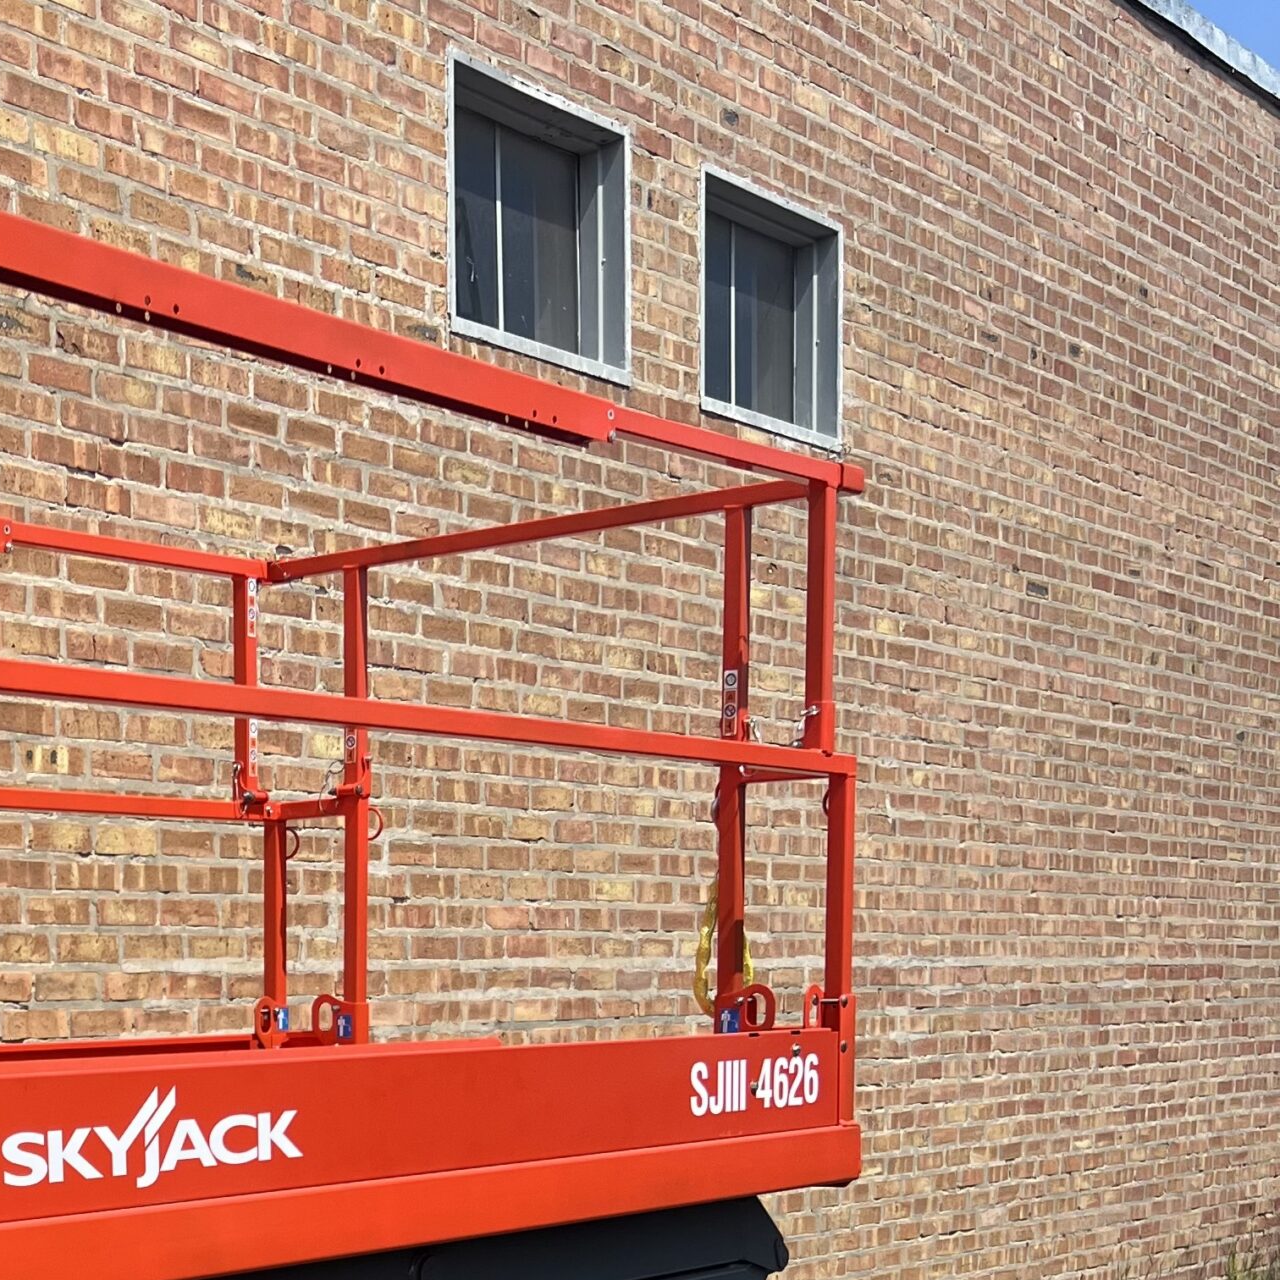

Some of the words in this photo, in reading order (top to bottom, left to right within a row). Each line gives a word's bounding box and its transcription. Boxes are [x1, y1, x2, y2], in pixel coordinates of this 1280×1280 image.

[690, 1059, 747, 1116] SJIII
[756, 1053, 819, 1109] 4626
[1, 1085, 303, 1188] SKYJACK
